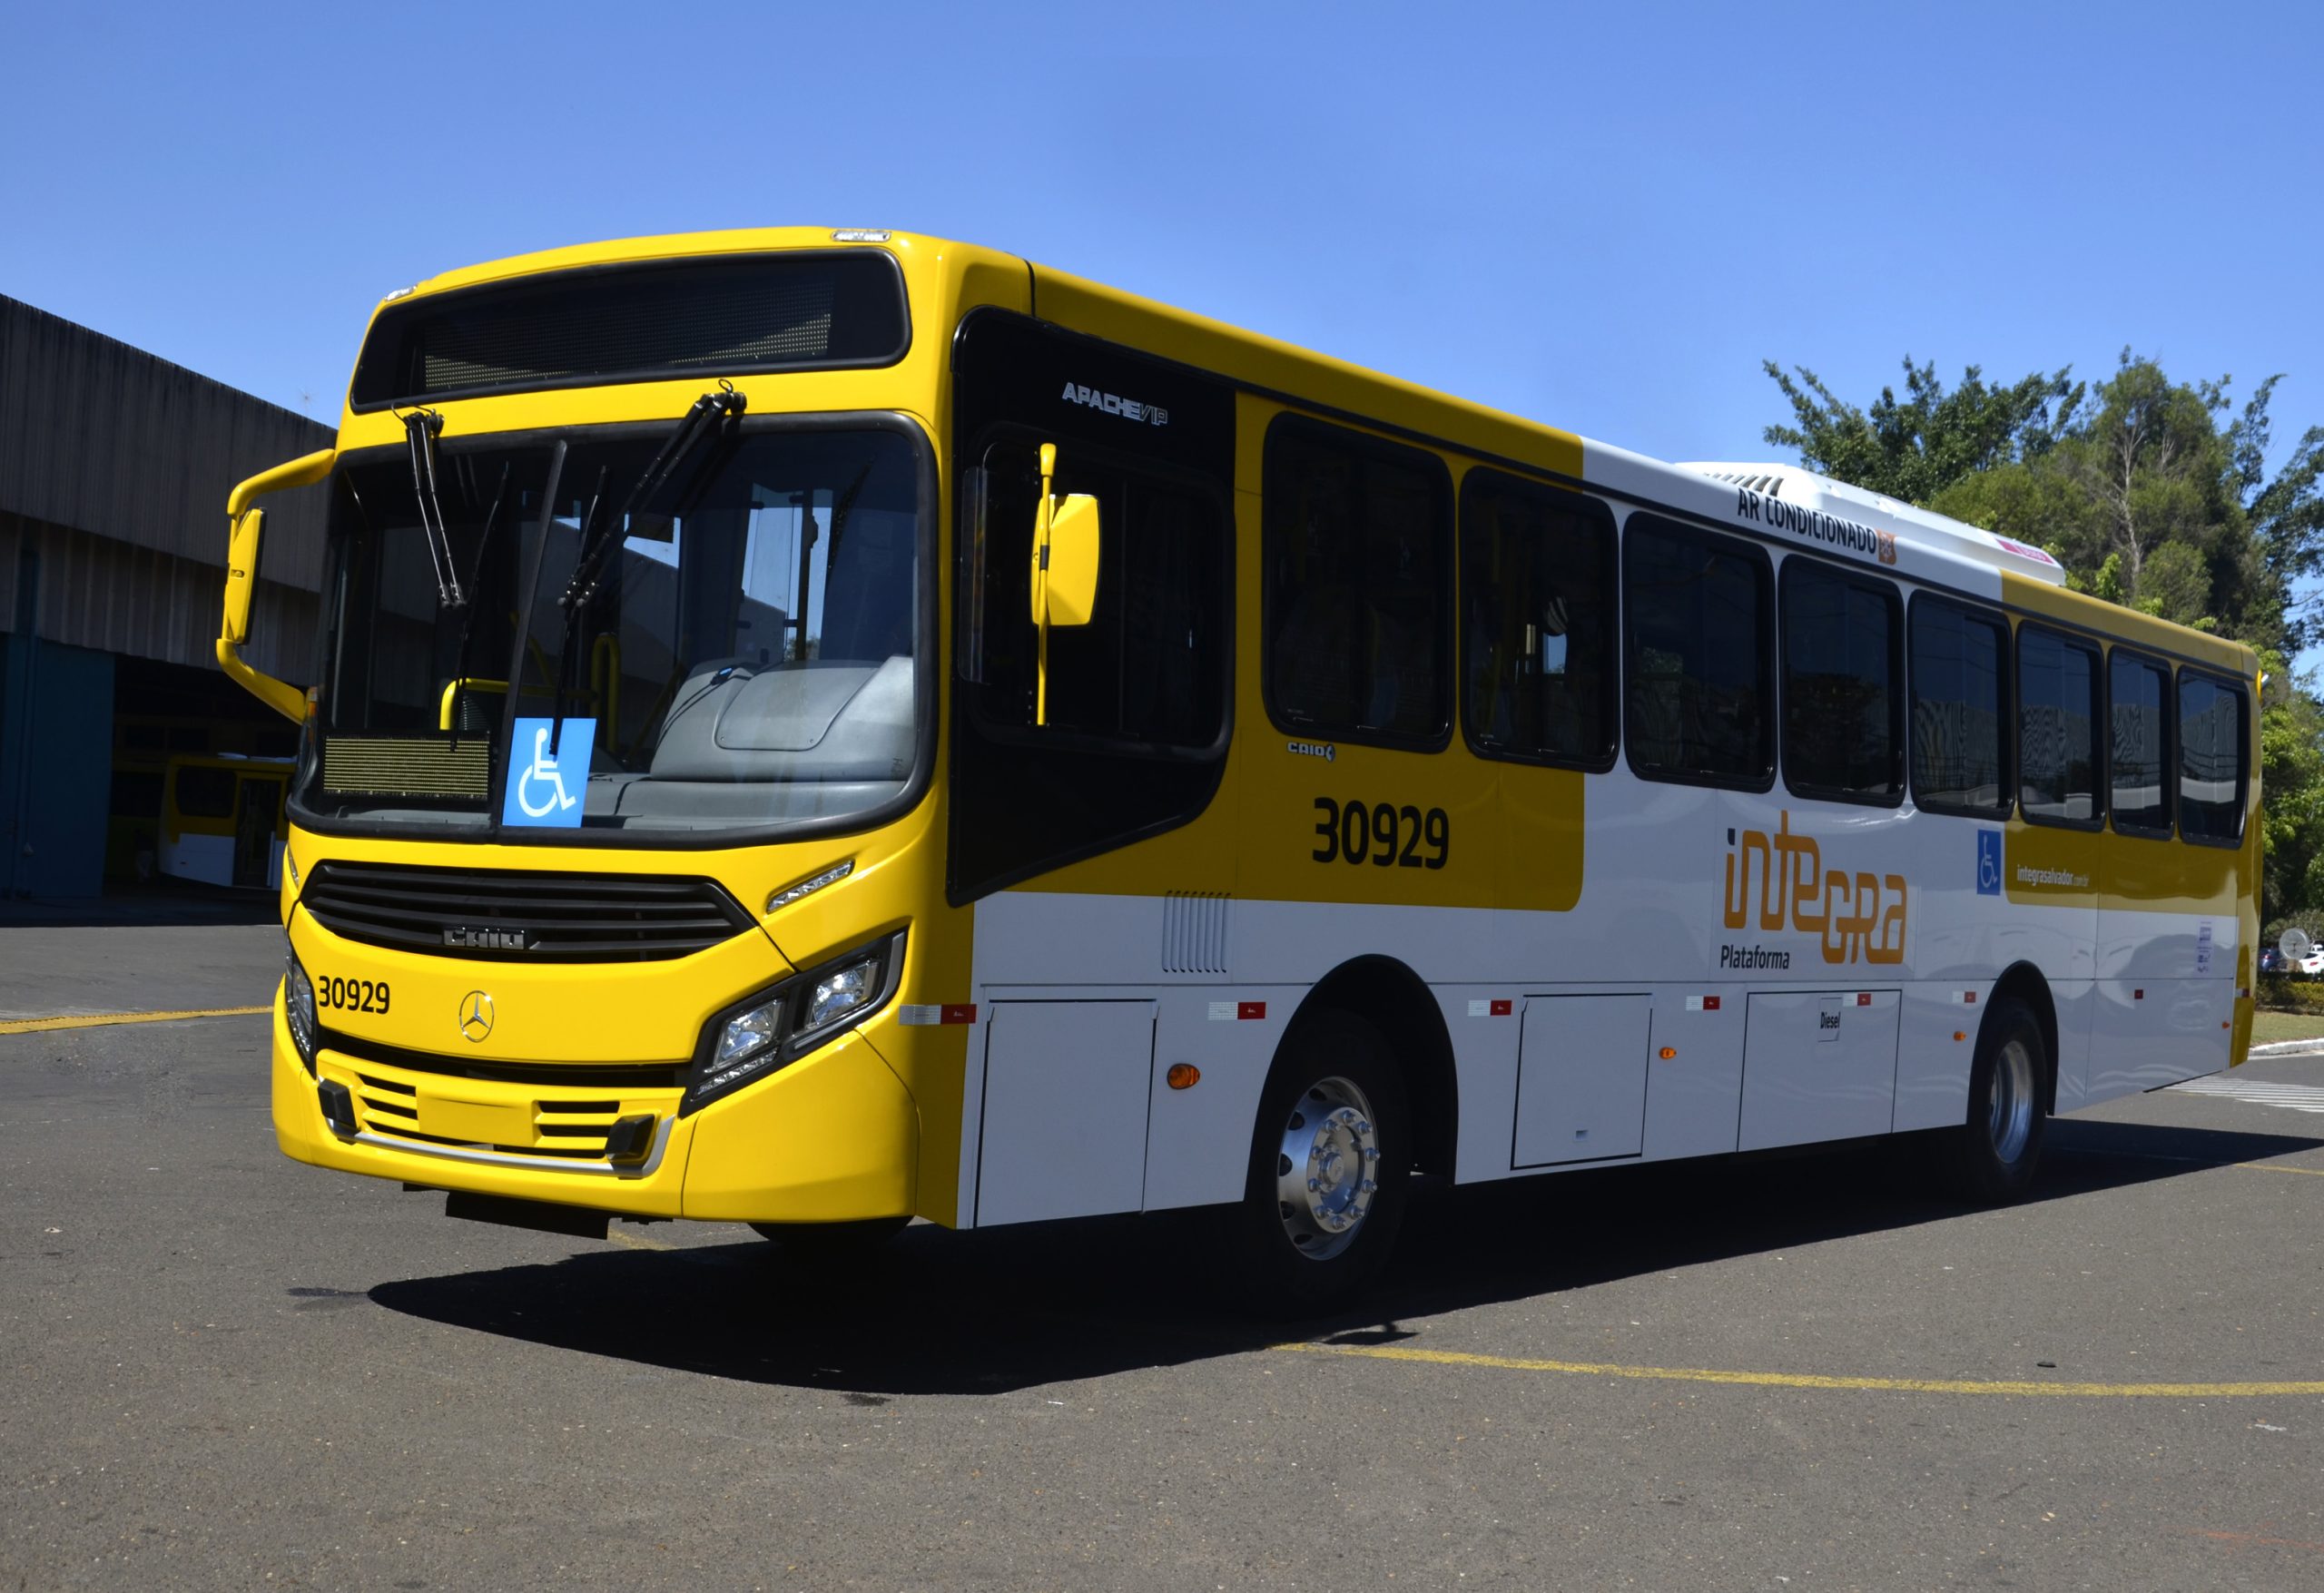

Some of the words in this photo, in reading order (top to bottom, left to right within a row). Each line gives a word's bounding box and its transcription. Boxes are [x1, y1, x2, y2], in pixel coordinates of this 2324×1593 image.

[1738, 487, 1759, 521] AR
[1766, 497, 1876, 555] CONDICIONADO
[1313, 797, 1449, 870] 30929
[1720, 945, 1790, 969] Plataforma
[319, 976, 390, 1015] 30929
[1820, 1011, 1841, 1029] Diesel
